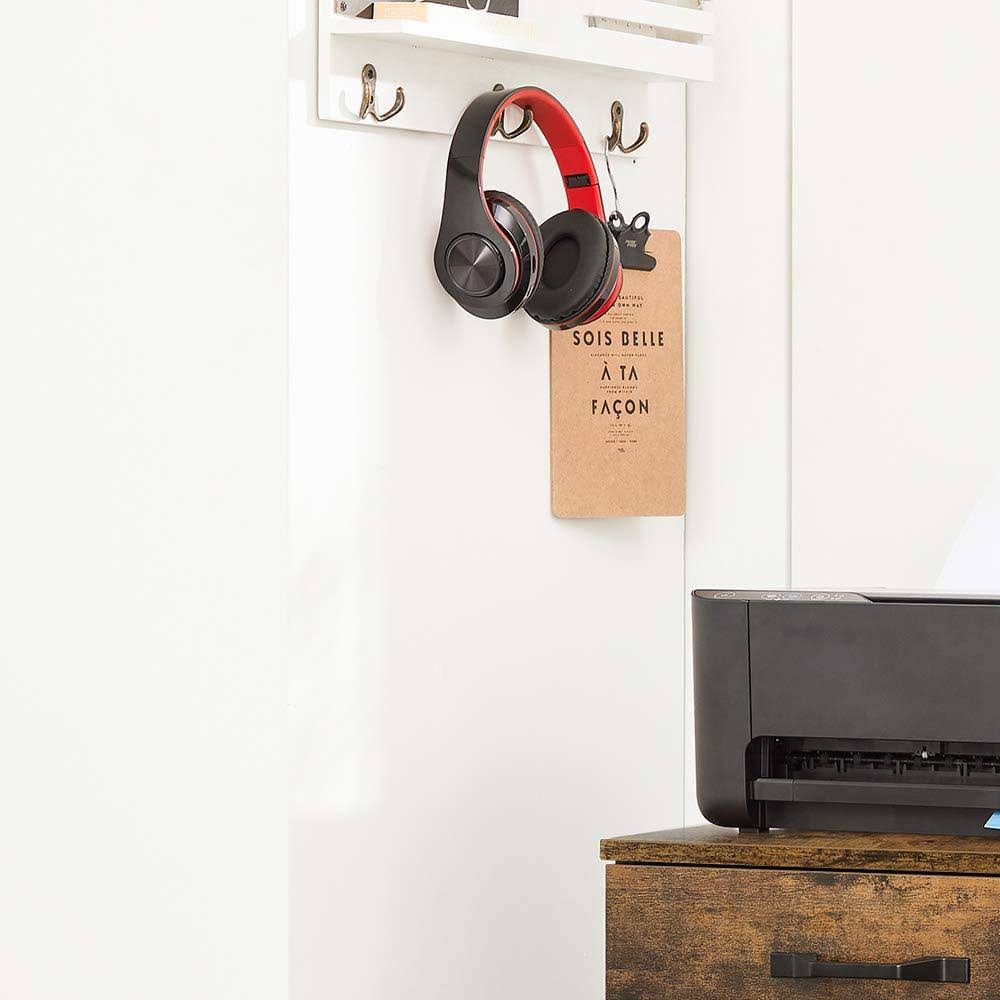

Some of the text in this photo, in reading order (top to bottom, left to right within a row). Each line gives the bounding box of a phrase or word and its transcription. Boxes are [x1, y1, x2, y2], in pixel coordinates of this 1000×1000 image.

[573, 330, 664, 346] SOIS BELLE
[601, 361, 638, 381] À TA
[592, 399, 649, 419] FAÇON
